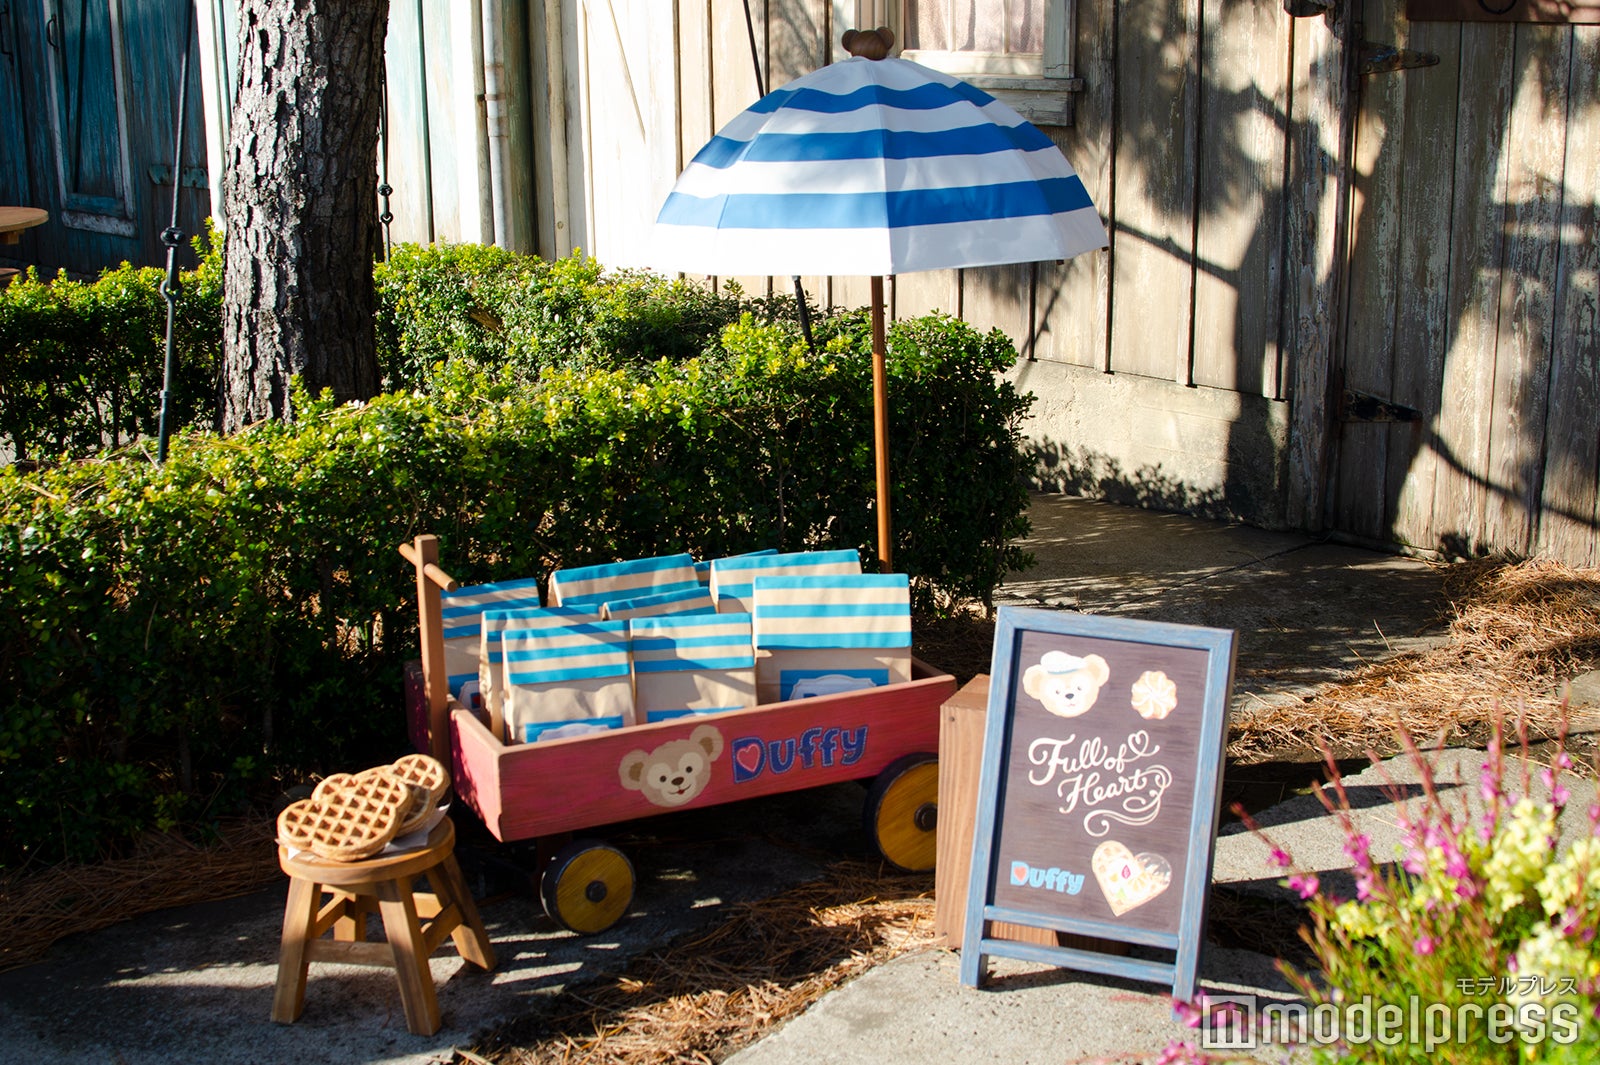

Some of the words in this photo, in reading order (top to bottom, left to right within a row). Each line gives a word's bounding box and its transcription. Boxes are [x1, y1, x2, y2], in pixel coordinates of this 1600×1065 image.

[732, 726, 868, 783] Duffy
[1028, 734, 1108, 785] Full
[1058, 765, 1172, 813] Heart
[1010, 861, 1085, 895] Duffy
